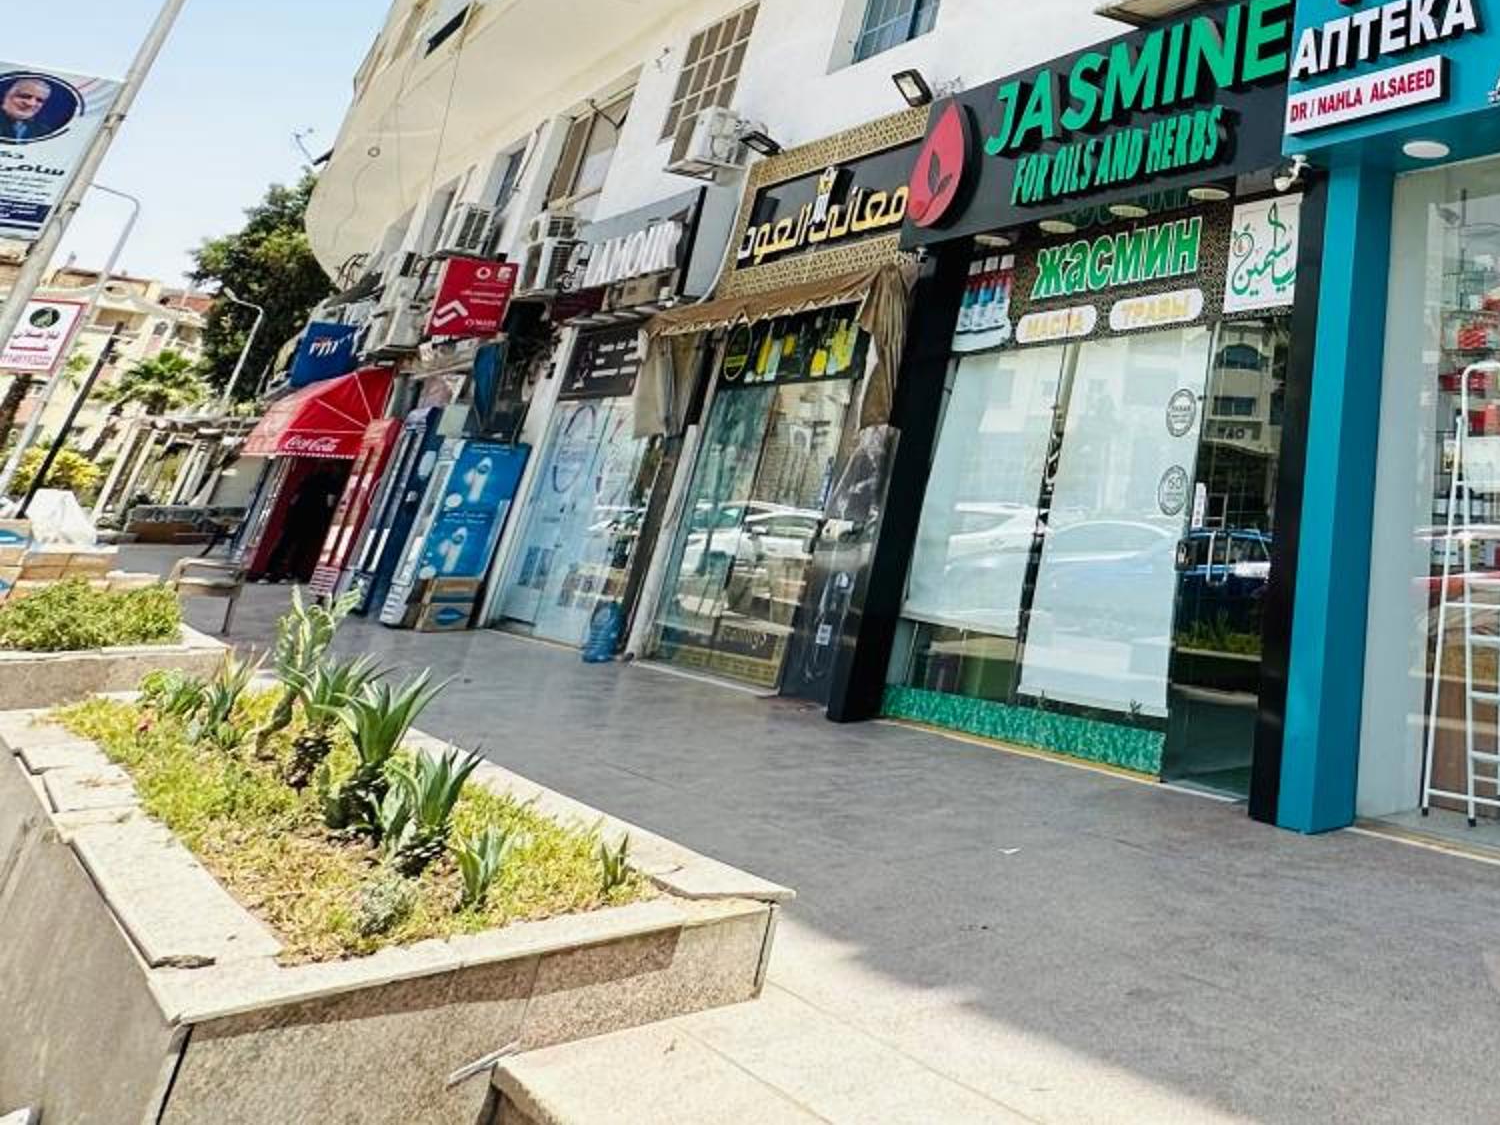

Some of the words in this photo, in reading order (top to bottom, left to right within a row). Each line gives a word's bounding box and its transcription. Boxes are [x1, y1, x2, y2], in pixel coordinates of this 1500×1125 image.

[1290, 101, 1307, 123] DR
[1317, 87, 1363, 116] NAHLA
[1369, 68, 1435, 104] ALSAEED
[1011, 153, 1050, 206] FOR
[1051, 138, 1098, 197] OILS
[1093, 128, 1145, 187] AND
[1145, 104, 1225, 174] HERBS
